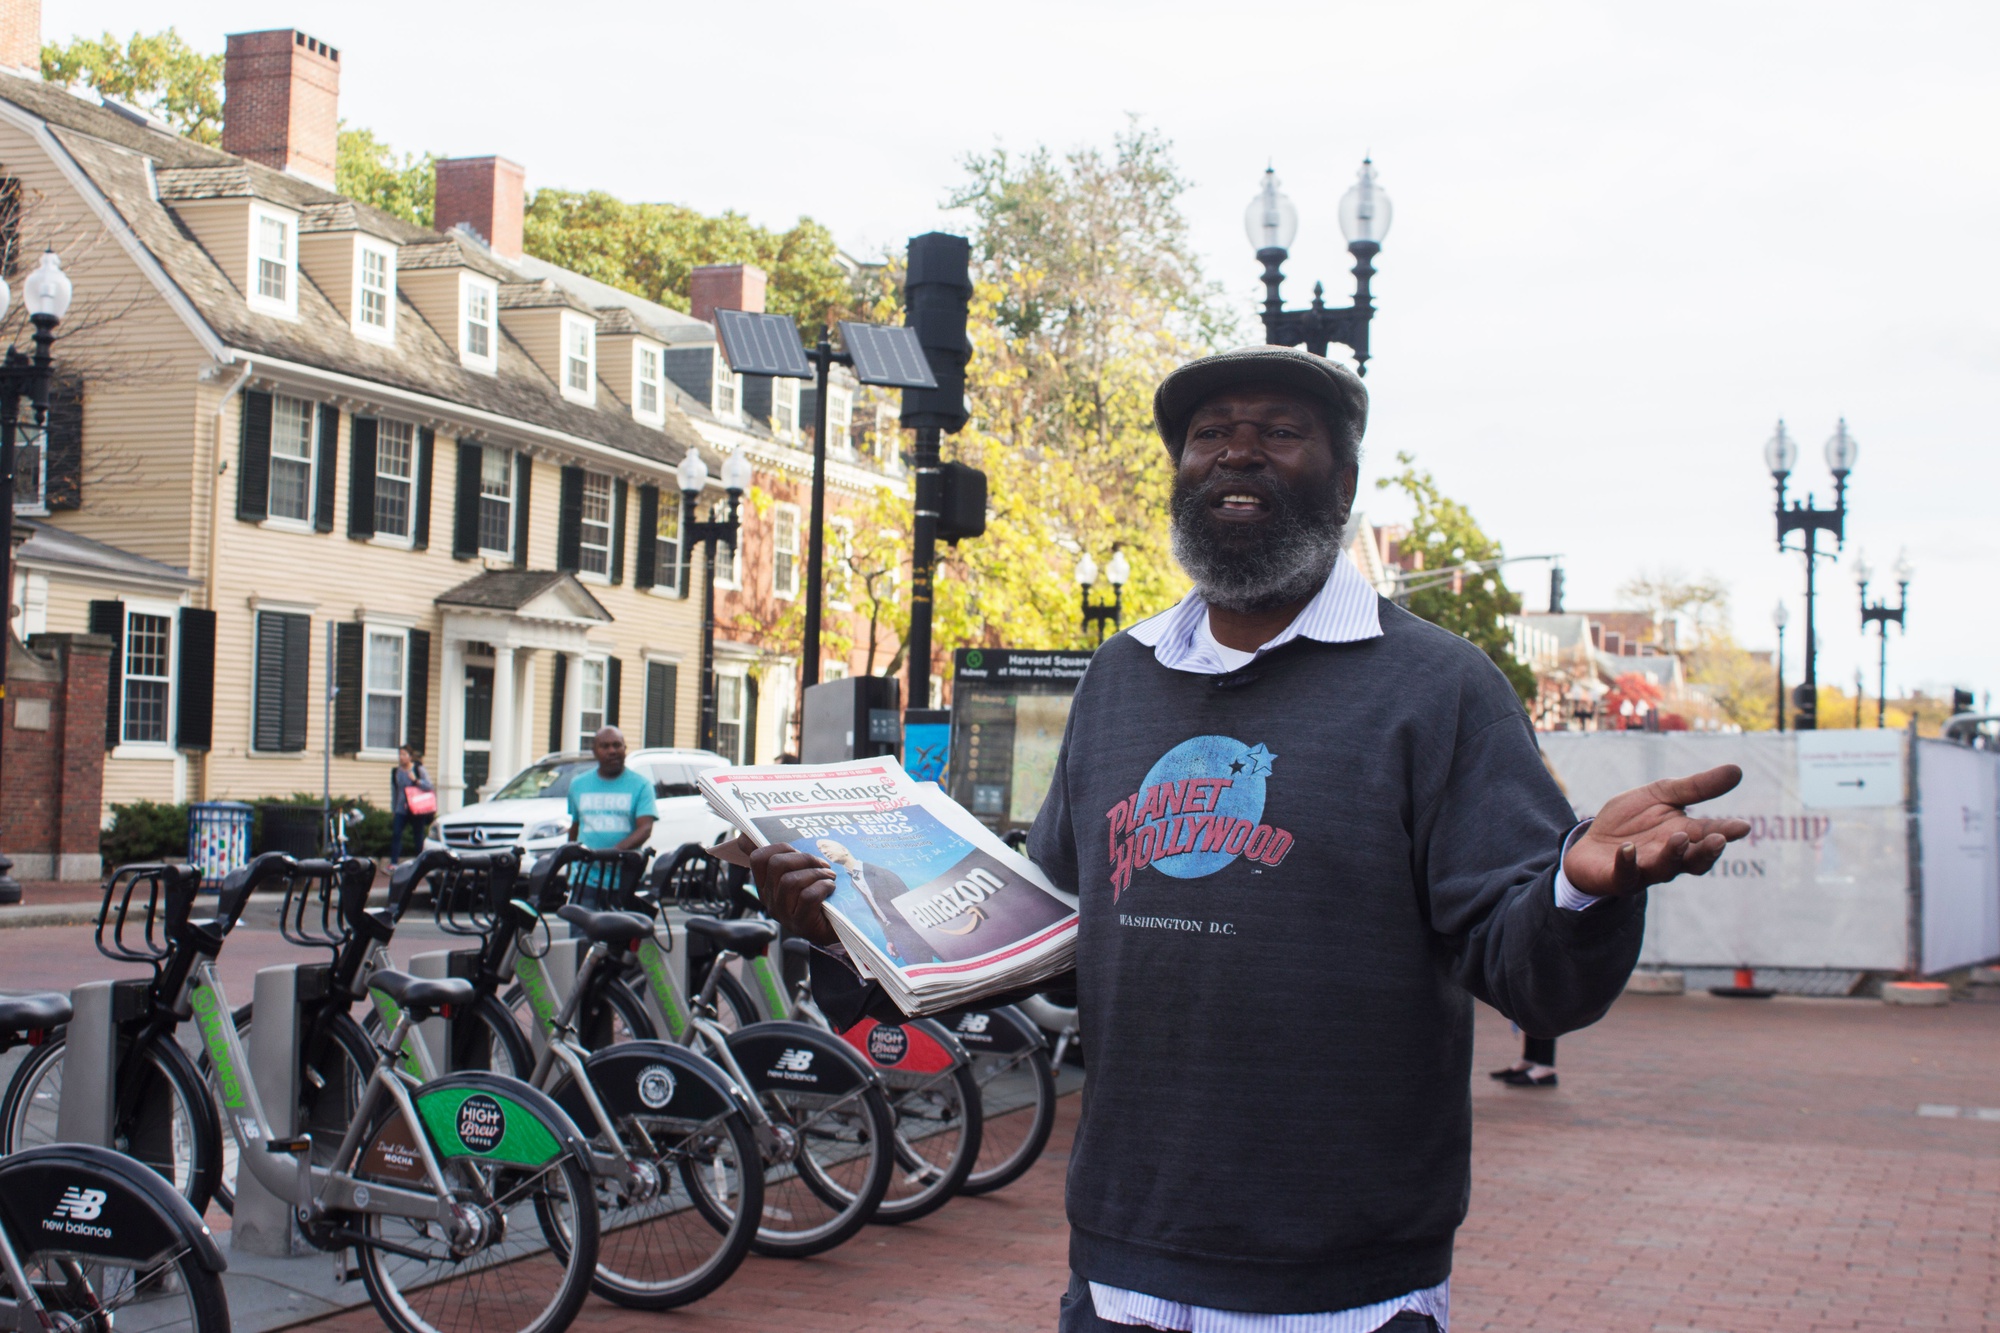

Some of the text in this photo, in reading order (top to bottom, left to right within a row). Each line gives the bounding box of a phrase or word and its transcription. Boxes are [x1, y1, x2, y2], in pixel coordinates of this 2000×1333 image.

[1009, 655, 1051, 666] Harvard
[960, 669, 988, 678] Hubway
[998, 668, 1008, 676] at
[1009, 668, 1032, 677] Mass
[811, 782, 898, 804] change
[780, 811, 909, 830] BOSTON SENDS
[1106, 778, 1233, 865] PLANET
[797, 822, 914, 839] BID TO BEZOS
[1110, 816, 1295, 905] HOLLYWOOD
[908, 868, 1005, 928] amazon
[1119, 914, 1236, 935] WASHINGTON D.C.
[872, 1030, 905, 1045] HIGH
[964, 1032, 993, 1042] balance
[200, 1010, 246, 1108] Hubway
[767, 1070, 818, 1082] new balance
[462, 1106, 501, 1124] HIGH
[460, 1120, 500, 1138] Brew
[465, 1136, 492, 1147] COFFEE
[383, 1153, 414, 1167] MOCHA
[42, 1218, 112, 1239] new balance
